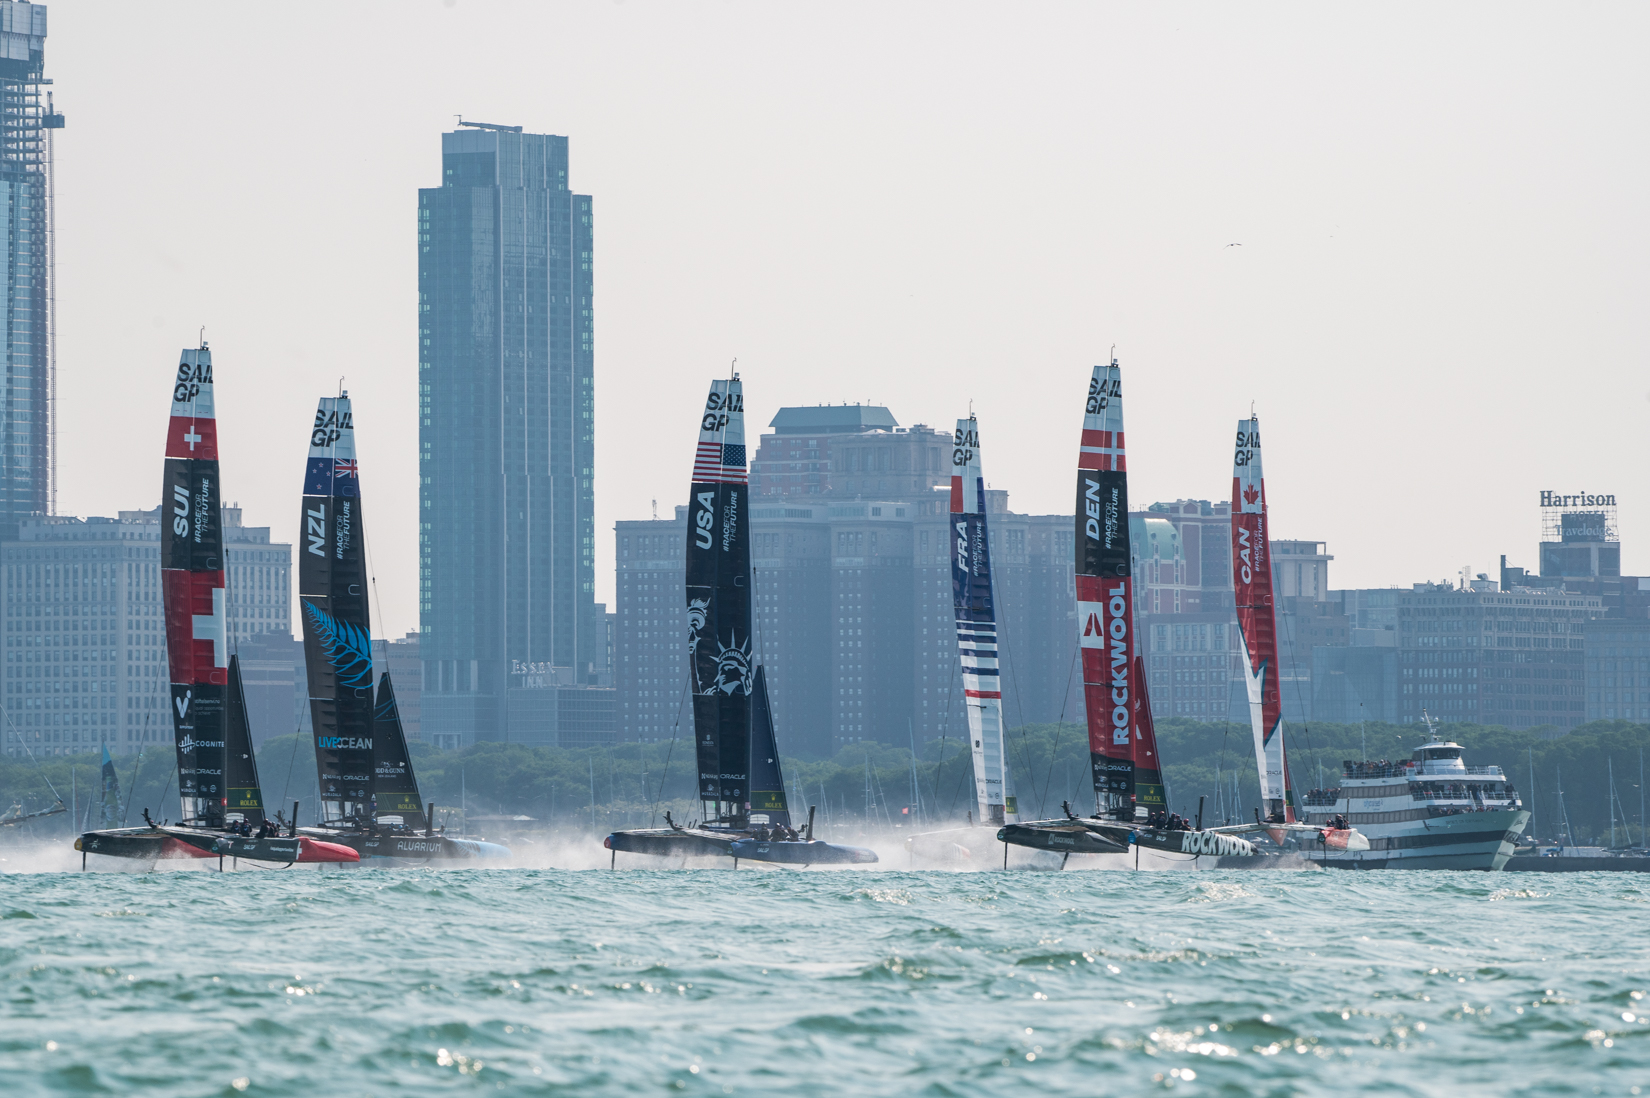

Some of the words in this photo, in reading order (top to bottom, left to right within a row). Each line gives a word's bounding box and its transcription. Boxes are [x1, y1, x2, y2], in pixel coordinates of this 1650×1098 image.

[177, 362, 213, 384] SAIL
[174, 383, 200, 403] GP
[1089, 377, 1122, 398] SAIL
[706, 392, 744, 412] SAIL
[1085, 395, 1108, 414] GP
[313, 409, 354, 429] SAIL
[701, 413, 730, 431] GP
[311, 428, 341, 448] GP
[954, 428, 980, 448] SAI
[952, 448, 973, 466] GP
[1235, 449, 1253, 466] GP
[1540, 490, 1617, 507] Harrison
[173, 484, 190, 538] SUI
[1085, 478, 1100, 541] DEN
[1569, 510, 1608, 521] HOTEL
[307, 504, 325, 557] NZL
[695, 491, 715, 550] USA
[1555, 523, 1614, 540] Travelodge
[956, 521, 969, 573] FRA
[1238, 527, 1251, 585] CAN
[511, 659, 556, 674] ESSEX
[1109, 581, 1130, 745] ROCKWOOL
[522, 676, 543, 688] INN
[195, 740, 225, 748] COGNITE
[397, 841, 442, 853] ALVARIUM
[1181, 830, 1254, 857] ROCKWOOL
